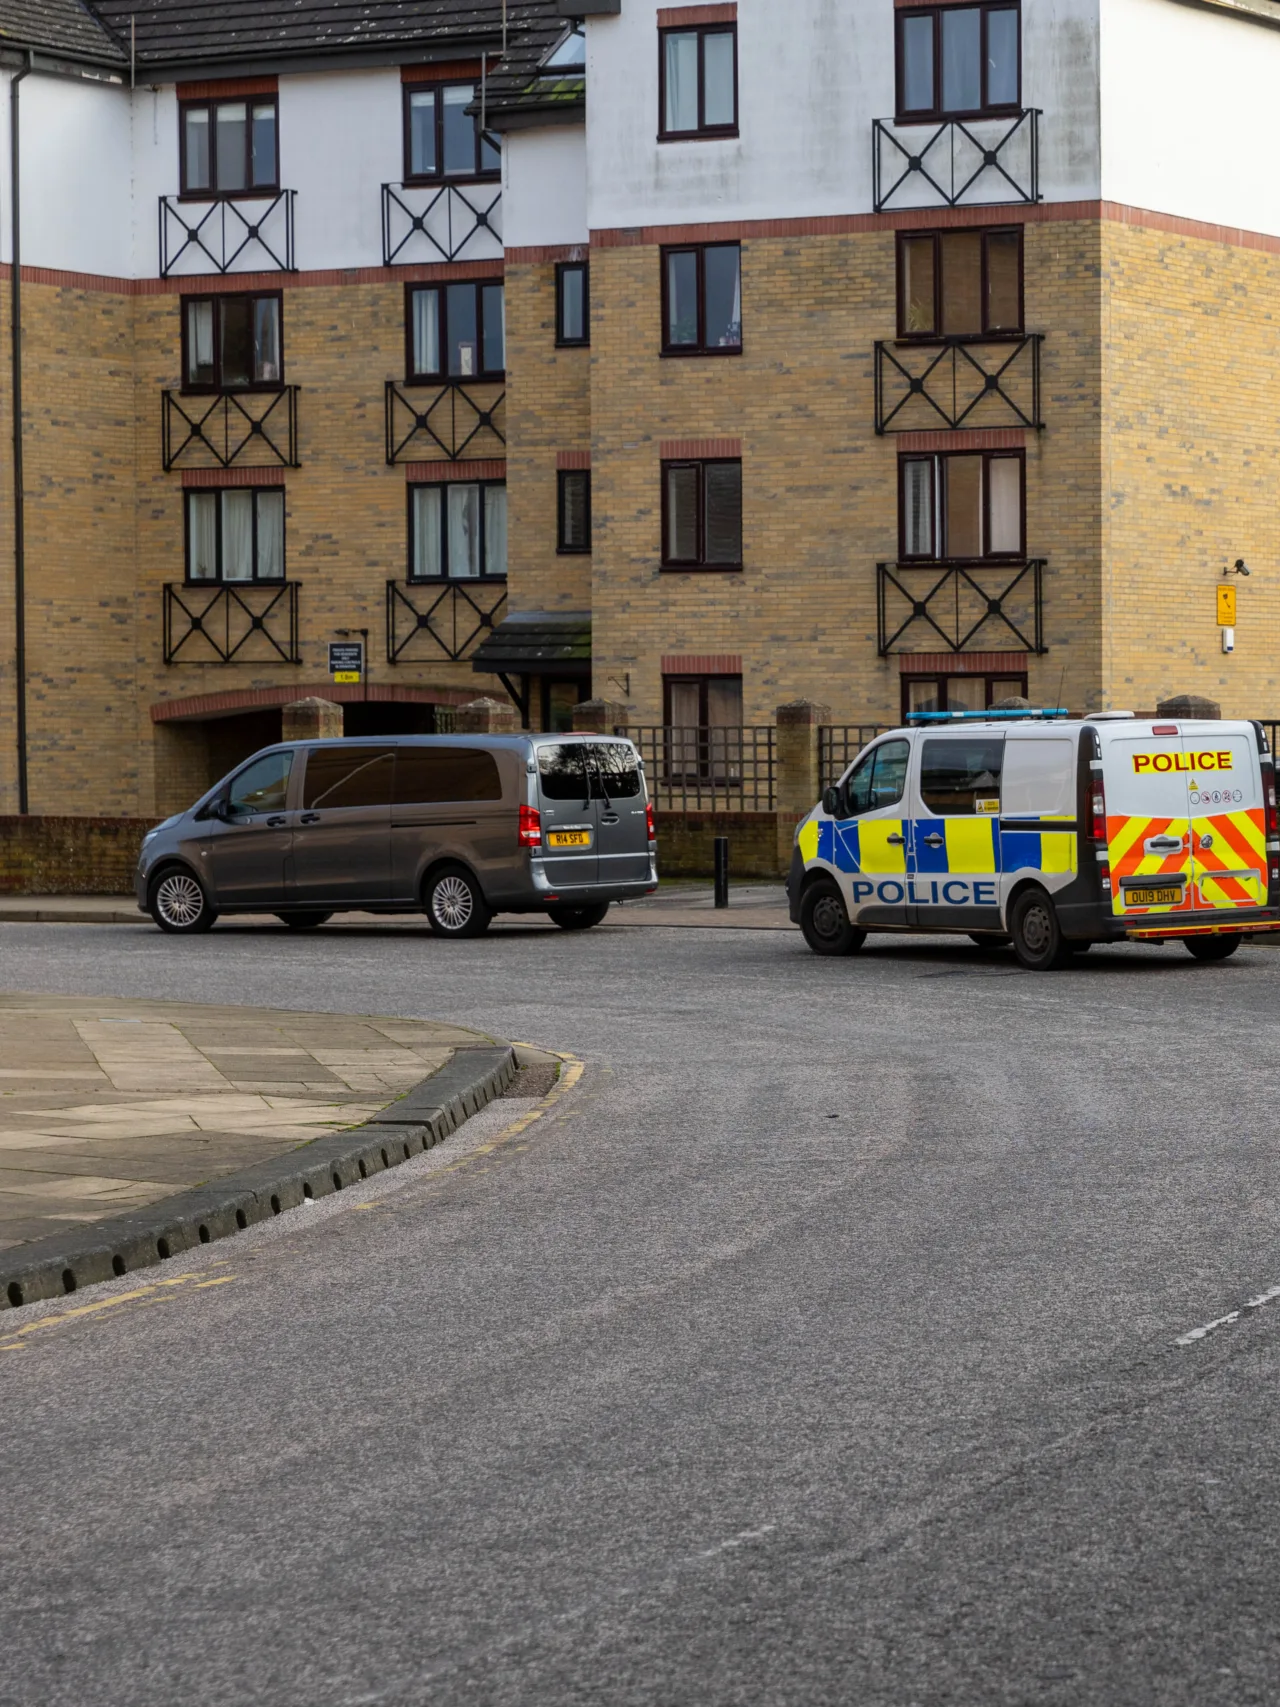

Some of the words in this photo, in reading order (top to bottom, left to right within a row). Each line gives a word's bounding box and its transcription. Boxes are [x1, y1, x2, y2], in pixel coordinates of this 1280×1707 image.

[1133, 751, 1232, 772] POLICE
[556, 834, 568, 844] R14
[852, 880, 997, 905] POLICE
[1131, 891, 1155, 903] OU19
[1157, 889, 1176, 901] DHV
